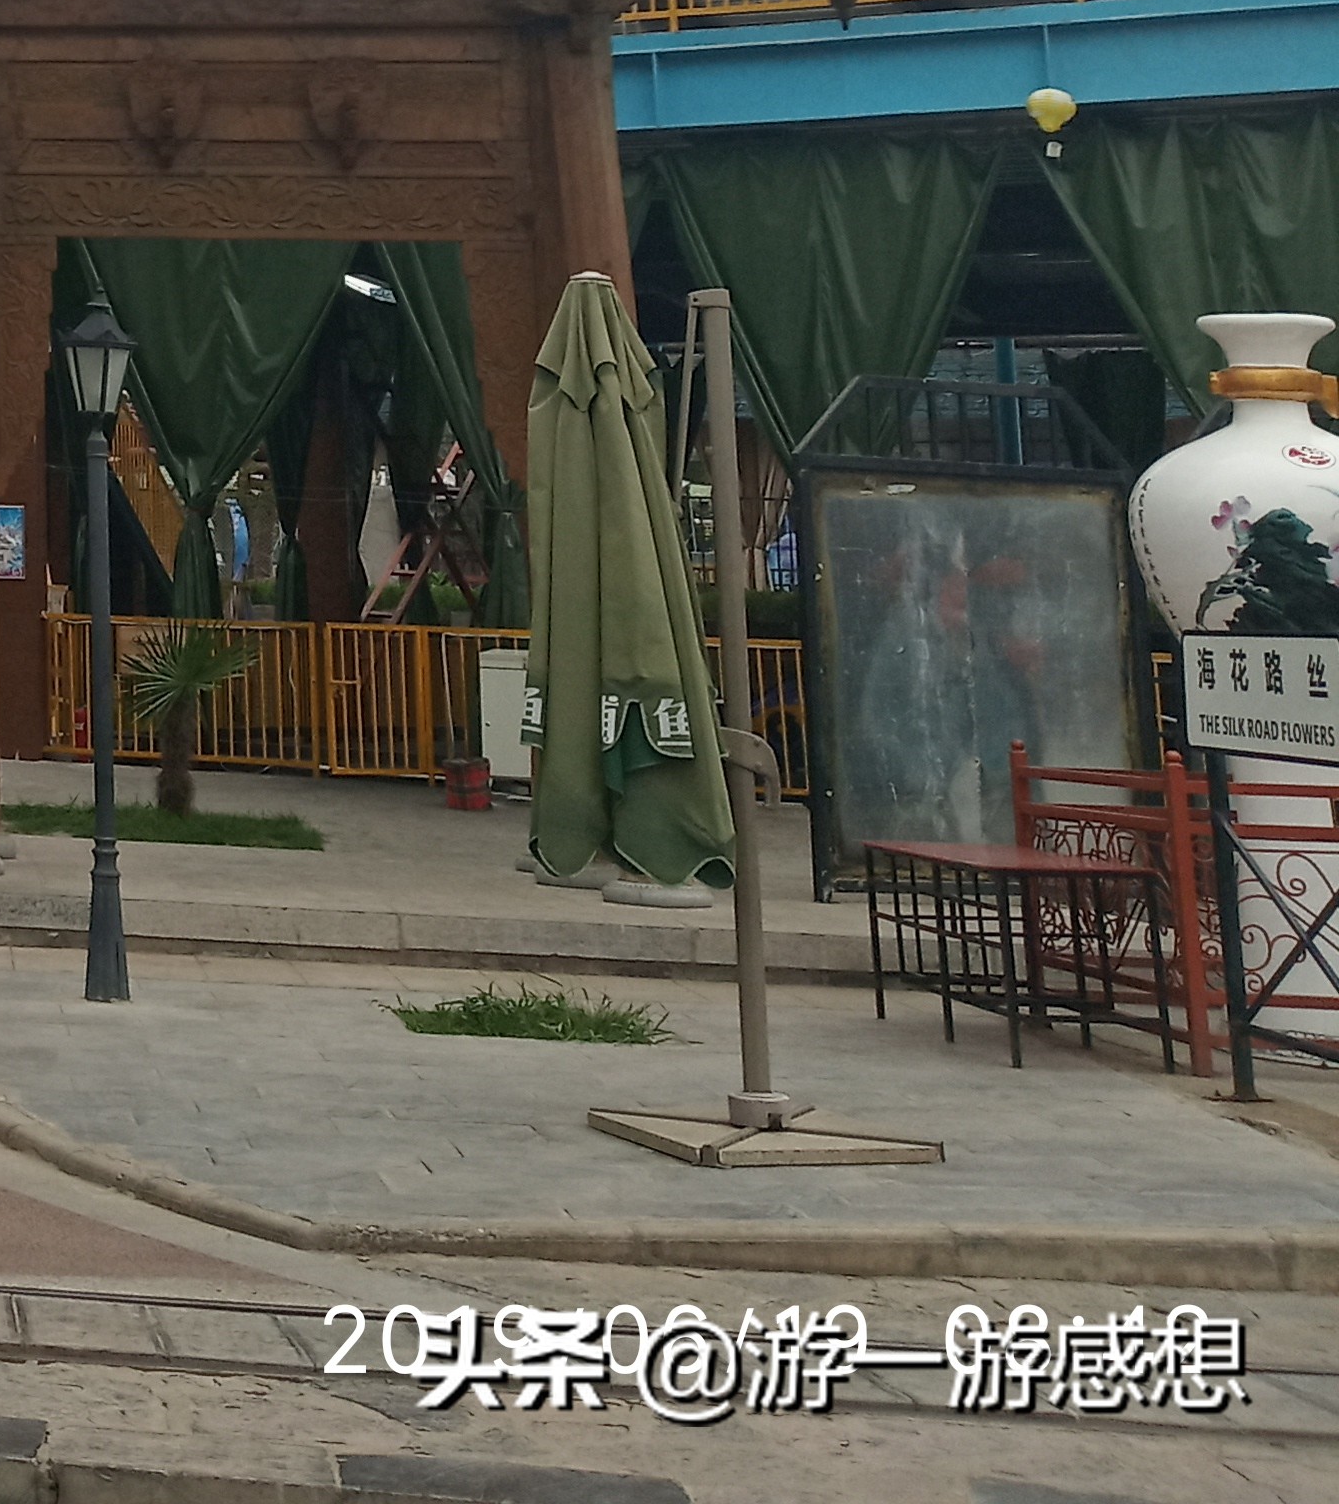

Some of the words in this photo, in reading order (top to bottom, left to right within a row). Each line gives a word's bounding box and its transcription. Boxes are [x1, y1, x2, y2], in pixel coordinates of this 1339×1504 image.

[1198, 714, 1221, 735] THE
[1222, 715, 1246, 738] SILK
[1247, 718, 1279, 741] ROAD
[1281, 721, 1336, 747] FLOWERS
